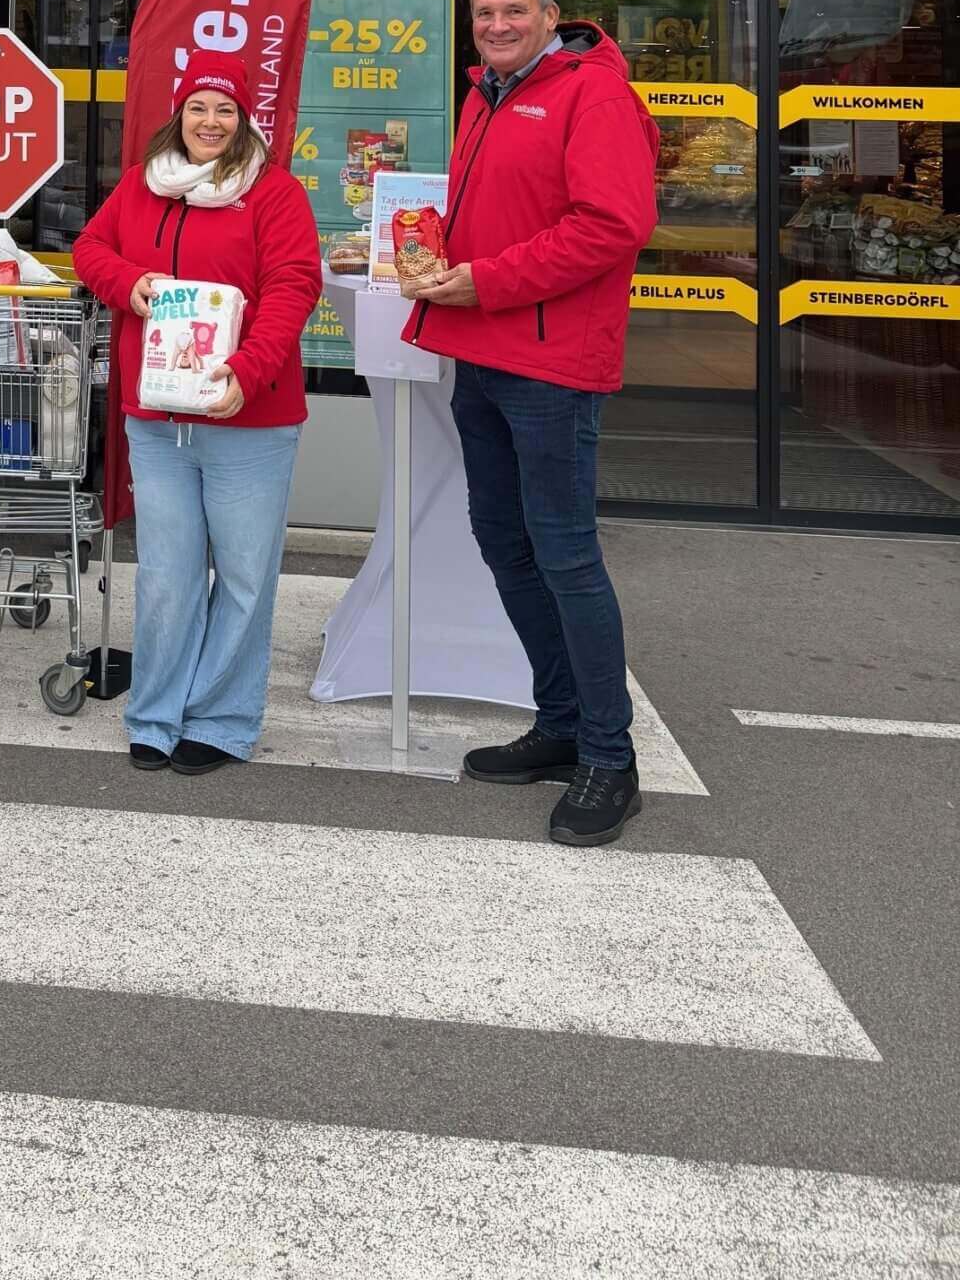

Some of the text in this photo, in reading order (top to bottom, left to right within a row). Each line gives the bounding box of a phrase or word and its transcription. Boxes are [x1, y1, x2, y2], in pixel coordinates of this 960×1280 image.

[648, 93, 724, 106] HERZLICH
[813, 96, 924, 110] WILLKOMMEN
[381, 196, 444, 206] Tag der Armut
[640, 286, 683, 298] BILLA
[687, 288, 726, 300] PLUS
[809, 290, 949, 308] STEINBERGDÖRFL
[153, 303, 200, 321] WELL
[149, 329, 162, 346] 4
